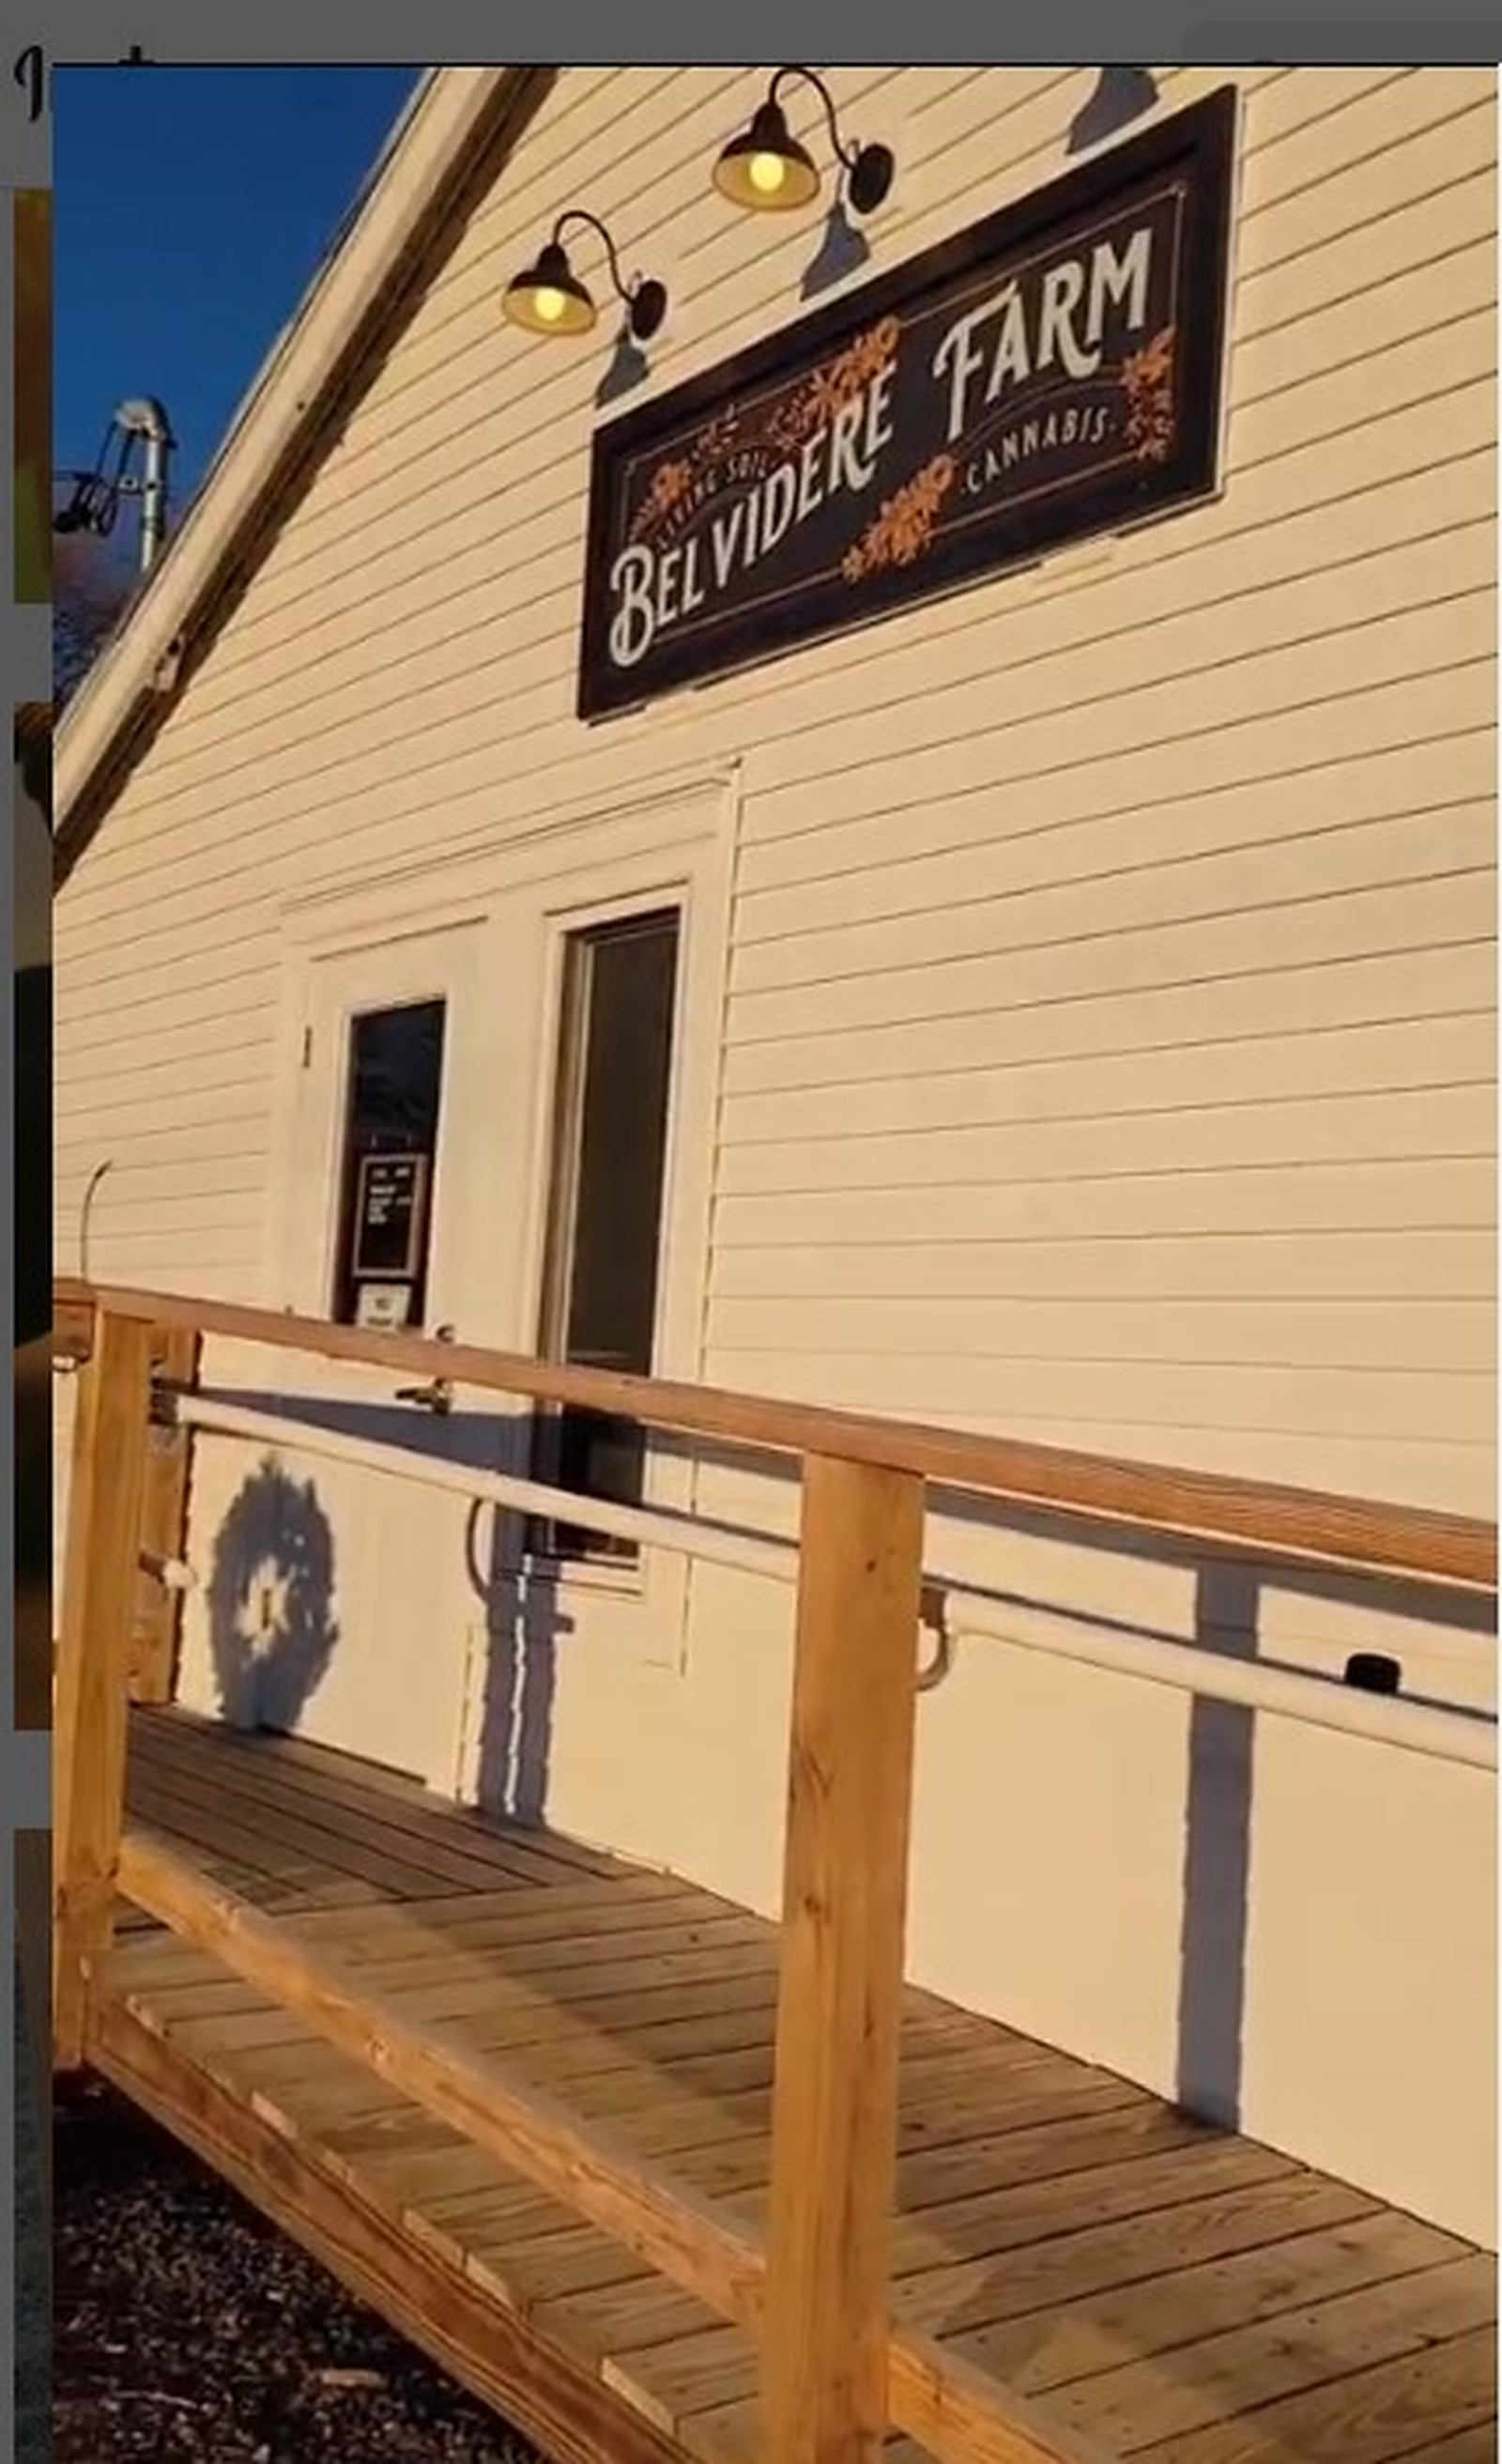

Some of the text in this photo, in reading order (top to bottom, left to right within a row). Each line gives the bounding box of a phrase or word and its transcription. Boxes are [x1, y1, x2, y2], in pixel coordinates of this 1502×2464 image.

[608, 229, 1152, 667] BELVIDERE FARM
[967, 408, 1108, 493] CANNABIS
